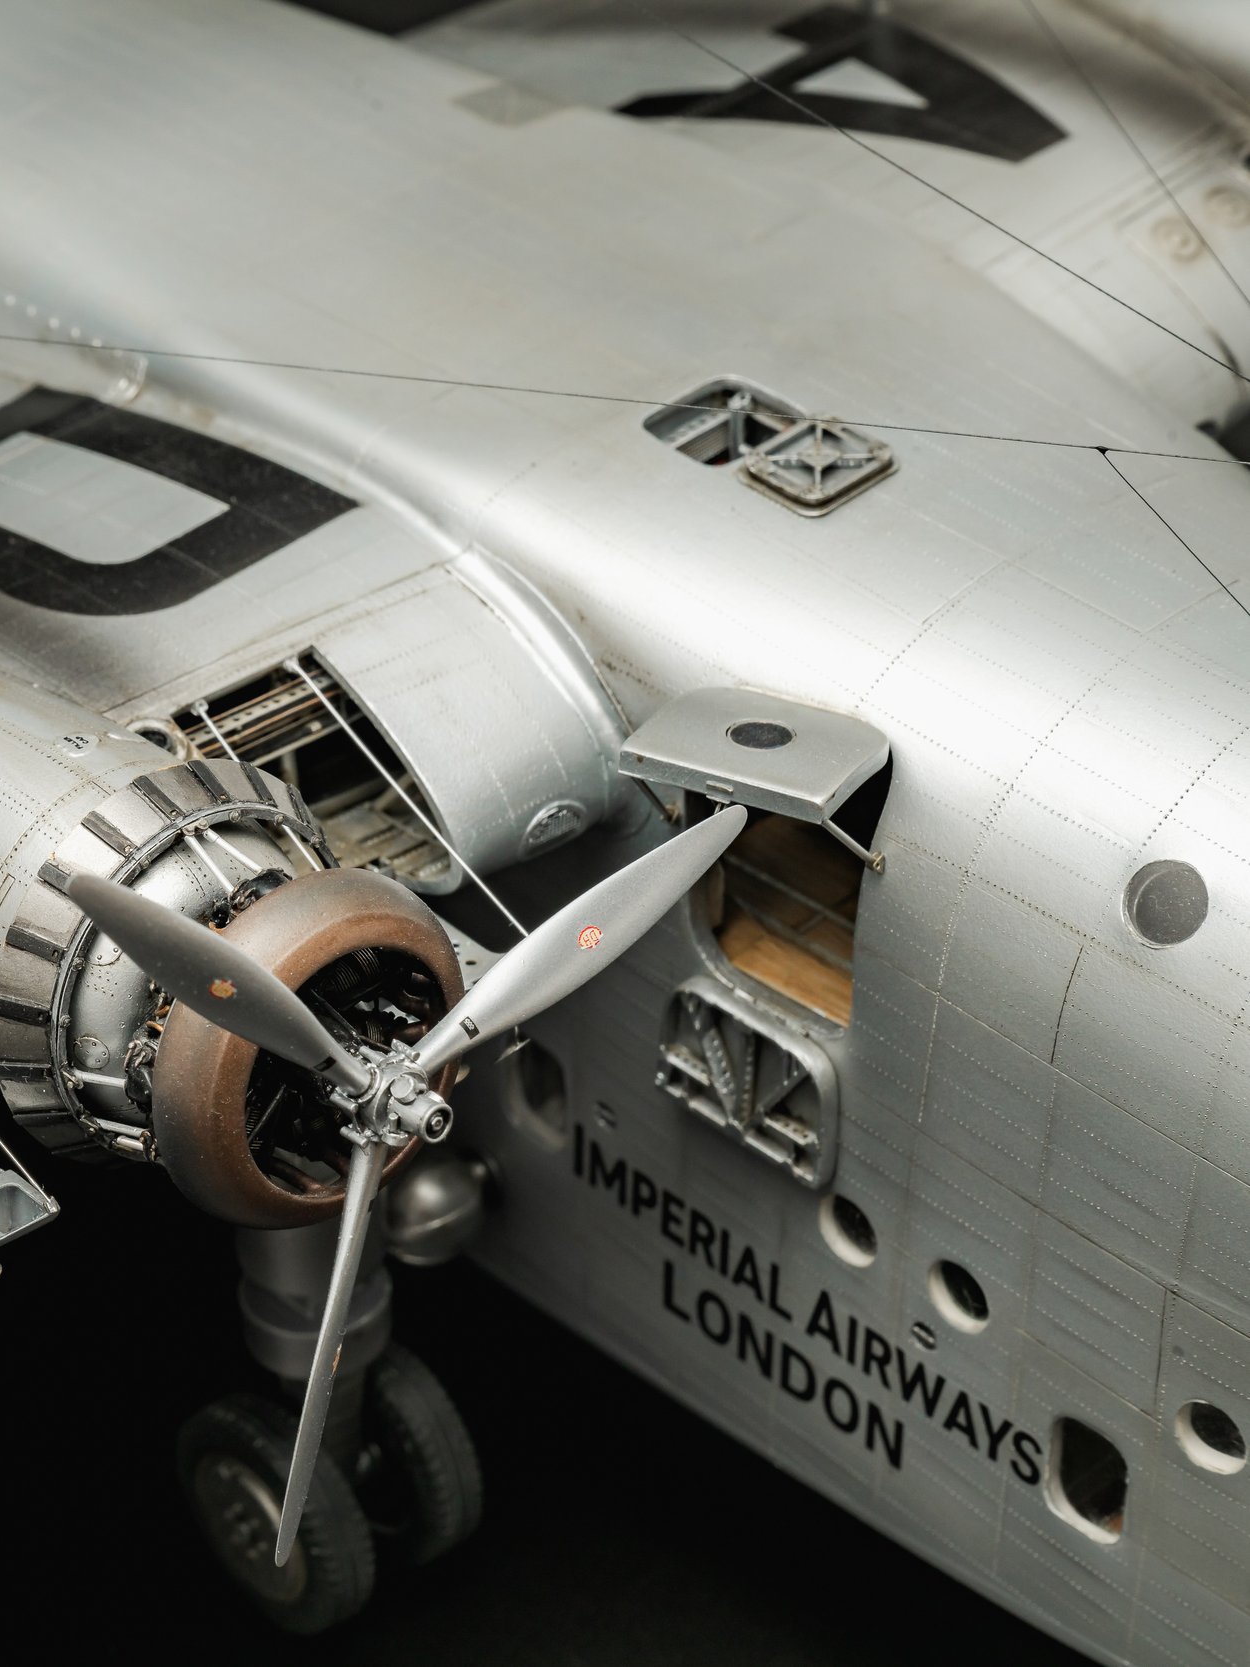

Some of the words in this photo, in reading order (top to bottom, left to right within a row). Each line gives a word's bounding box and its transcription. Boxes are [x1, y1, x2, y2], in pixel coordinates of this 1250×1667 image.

[613, 4, 1069, 163] A
[572, 1123, 793, 1322] IMPERIAL
[806, 1290, 1043, 1487] AIRWAYS
[662, 1259, 905, 1472] LONDON
